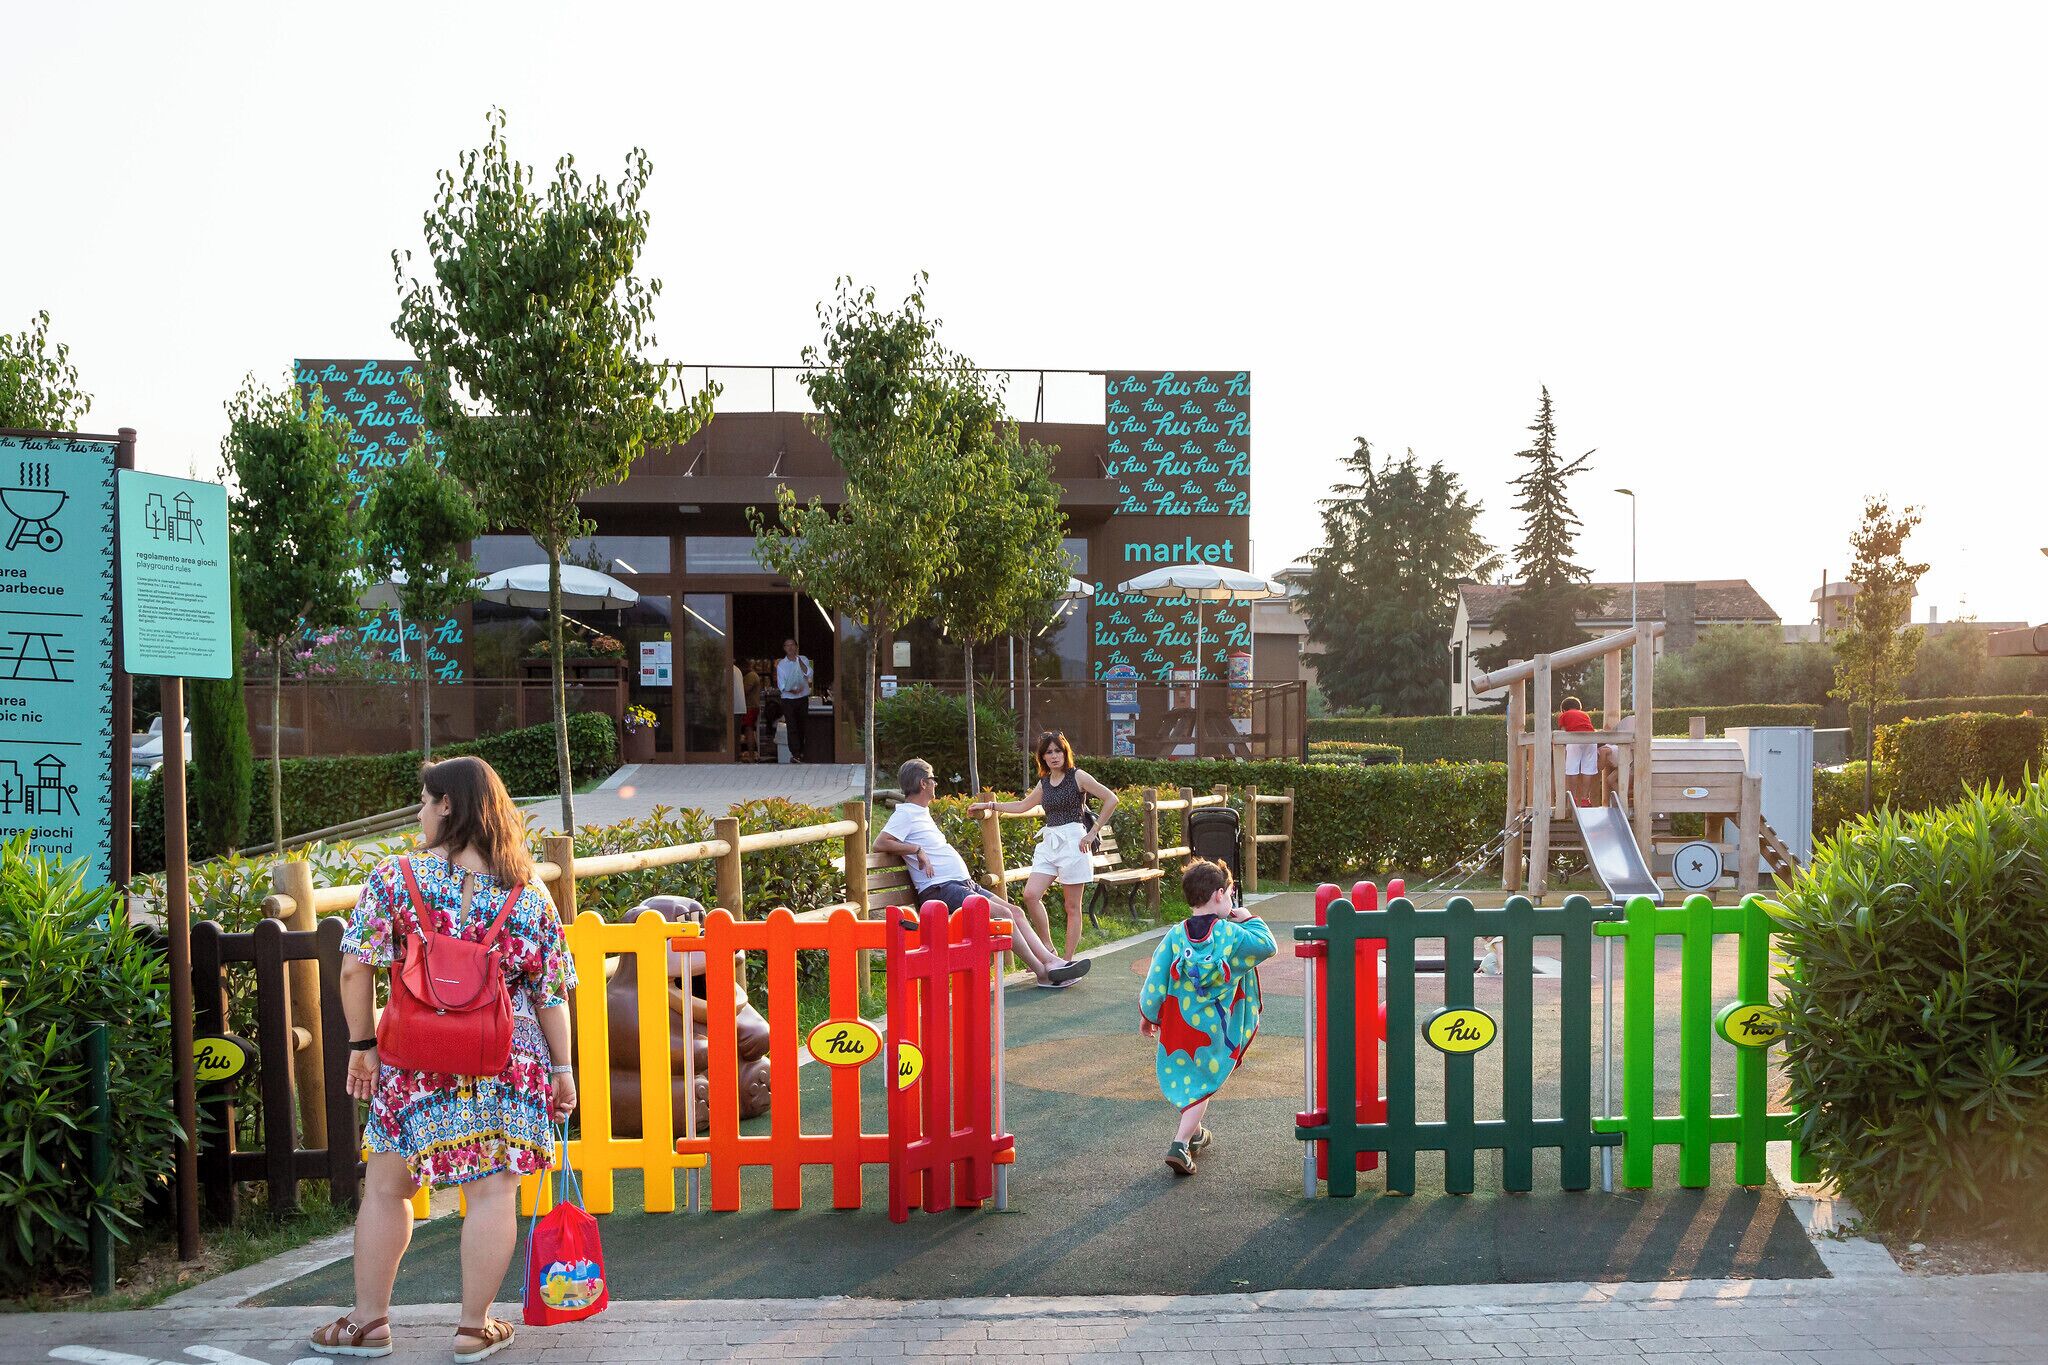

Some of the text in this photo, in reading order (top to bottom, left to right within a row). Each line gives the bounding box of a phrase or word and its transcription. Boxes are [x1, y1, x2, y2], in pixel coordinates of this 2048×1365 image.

[320, 364, 348, 383] hu
[354, 360, 395, 386] hu
[1120, 376, 1147, 393] hu
[1152, 372, 1191, 396] hu
[1193, 376, 1219, 393] hu
[342, 387, 366, 402] hu
[384, 390, 407, 405] hu
[354, 401, 395, 427] hu
[397, 406, 425, 425] hu
[1108, 397, 1236, 414] hu hu hu hu
[1120, 415, 1147, 433] hu
[1152, 411, 1191, 436] hu
[1192, 416, 1219, 433] hu
[20, 437, 42, 450] hu
[44, 440, 60, 451] hu
[64, 440, 88, 453] hu
[88, 442, 105, 453] hu
[347, 428, 366, 444] hu
[384, 431, 407, 446] hu
[1108, 437, 1236, 454] hu hu hu hu
[1120, 455, 1147, 473] hu
[1152, 451, 1191, 476] hu
[1193, 456, 1219, 473] hu
[1142, 477, 1164, 492] hu
[1180, 479, 1202, 494] hu
[1214, 478, 1236, 492] hu
[1120, 495, 1147, 512] hu
[1152, 491, 1191, 516] hu
[1193, 496, 1219, 512] hu
[1124, 536, 1233, 563] market
[136, 552, 217, 567] regolamento area giochi
[136, 561, 191, 573] playground rules
[1109, 610, 1130, 625] hu
[1142, 609, 1164, 623] hu
[1214, 609, 1236, 623] hu
[358, 618, 400, 644] hu
[1121, 626, 1147, 644] hu
[1153, 622, 1192, 646] hu
[426, 646, 447, 661] hu
[1108, 650, 1129, 664] hu
[1141, 649, 1163, 662] hu
[22, 711, 43, 722] nic
[30, 826, 73, 840] giochi
[1444, 1018, 1480, 1041] hu
[826, 1030, 864, 1053] hu
[193, 1046, 231, 1070] hu
